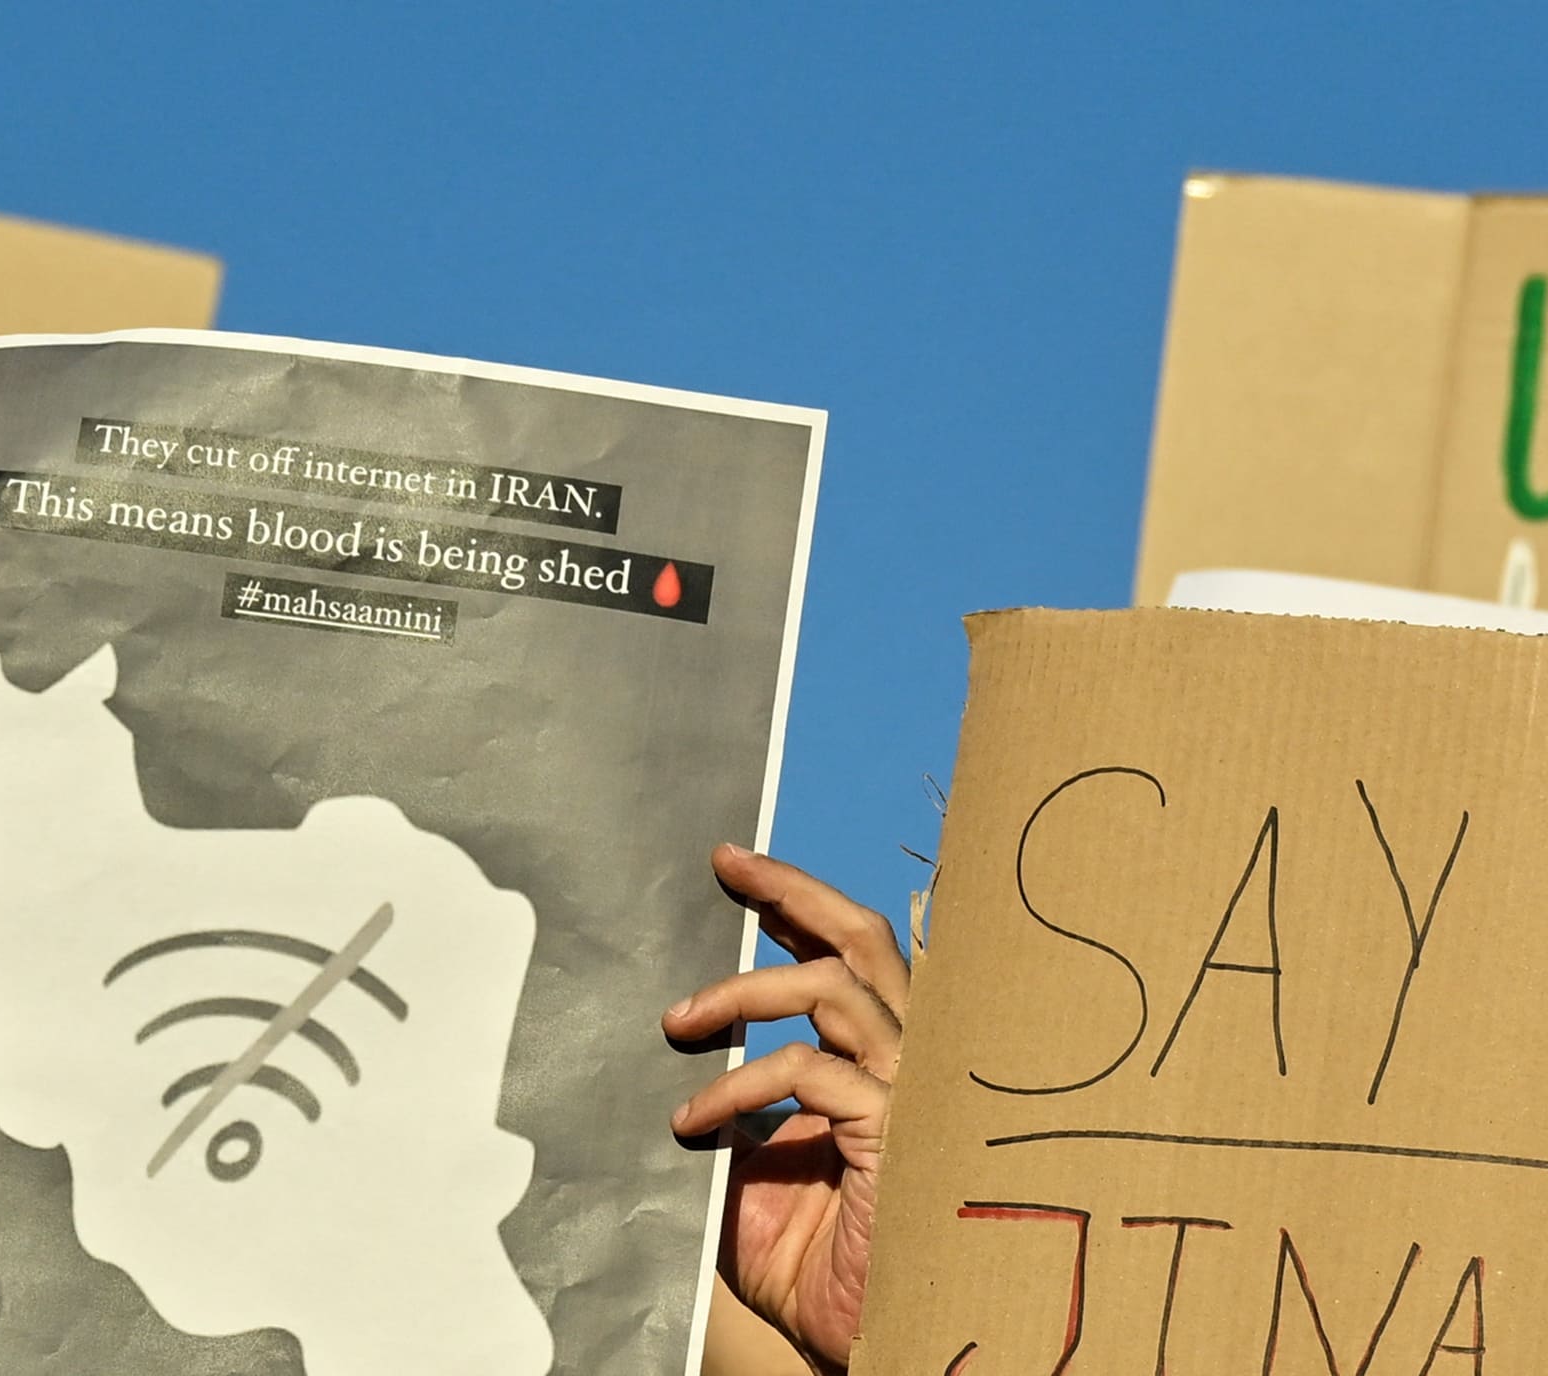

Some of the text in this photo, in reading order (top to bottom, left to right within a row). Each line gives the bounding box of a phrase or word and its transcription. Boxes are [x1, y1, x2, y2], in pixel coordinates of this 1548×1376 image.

[94, 424, 602, 518] They cut off internet in IRAN.
[7, 479, 630, 594] This means blood is being shed
[235, 581, 442, 634] #mahsaamini
[971, 767, 1468, 1100] SAY
